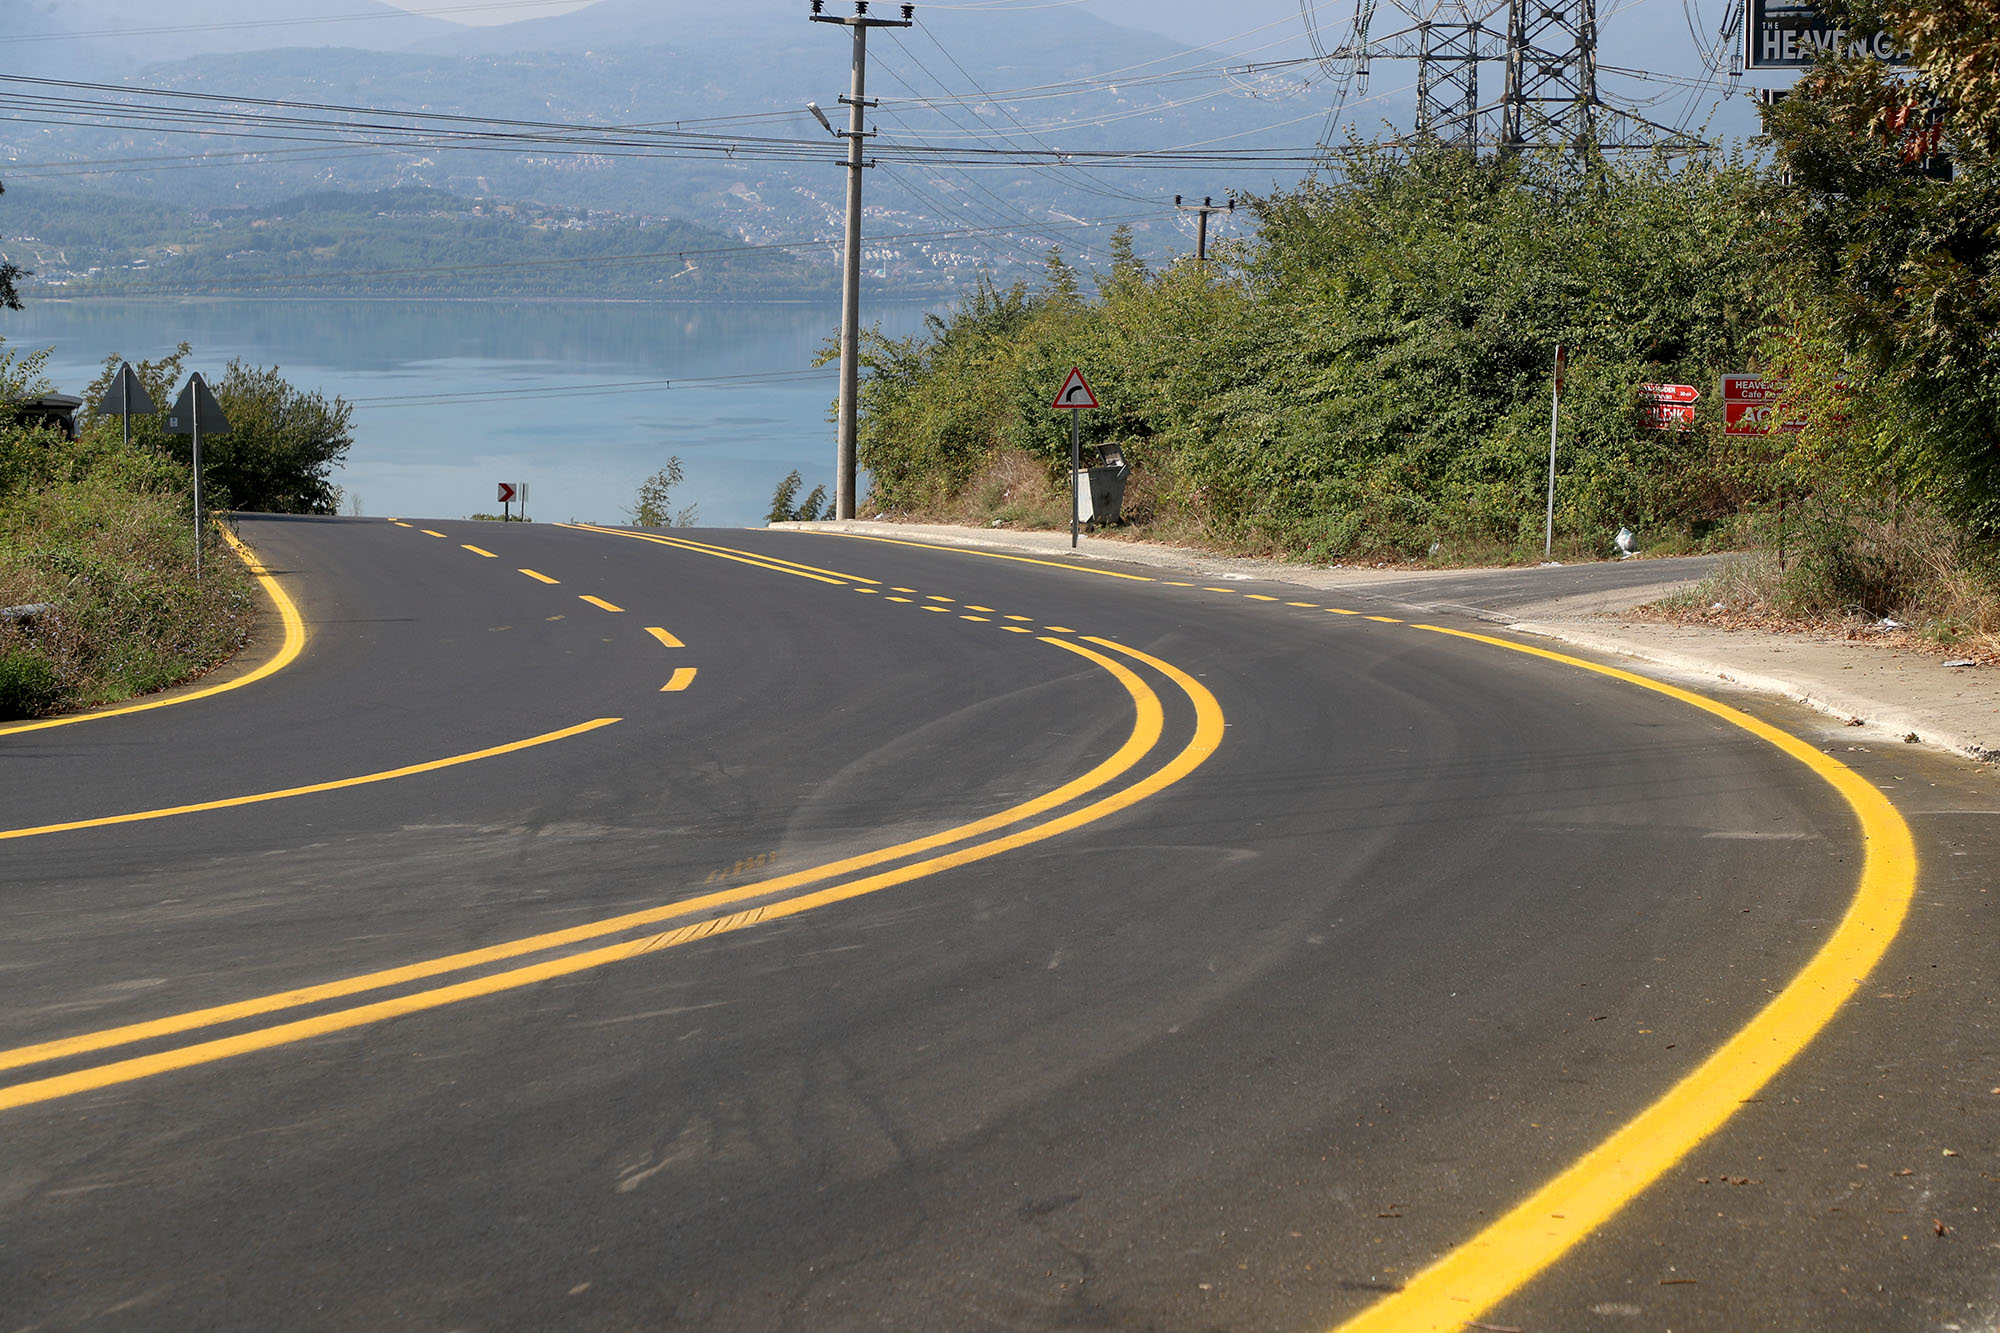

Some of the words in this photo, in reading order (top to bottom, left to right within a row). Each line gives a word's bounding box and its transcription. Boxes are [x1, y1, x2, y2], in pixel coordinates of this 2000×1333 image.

[1762, 21, 1779, 30] THE
[1762, 29, 1867, 60] HEAVEN
[1741, 389, 1762, 399] Cafe
